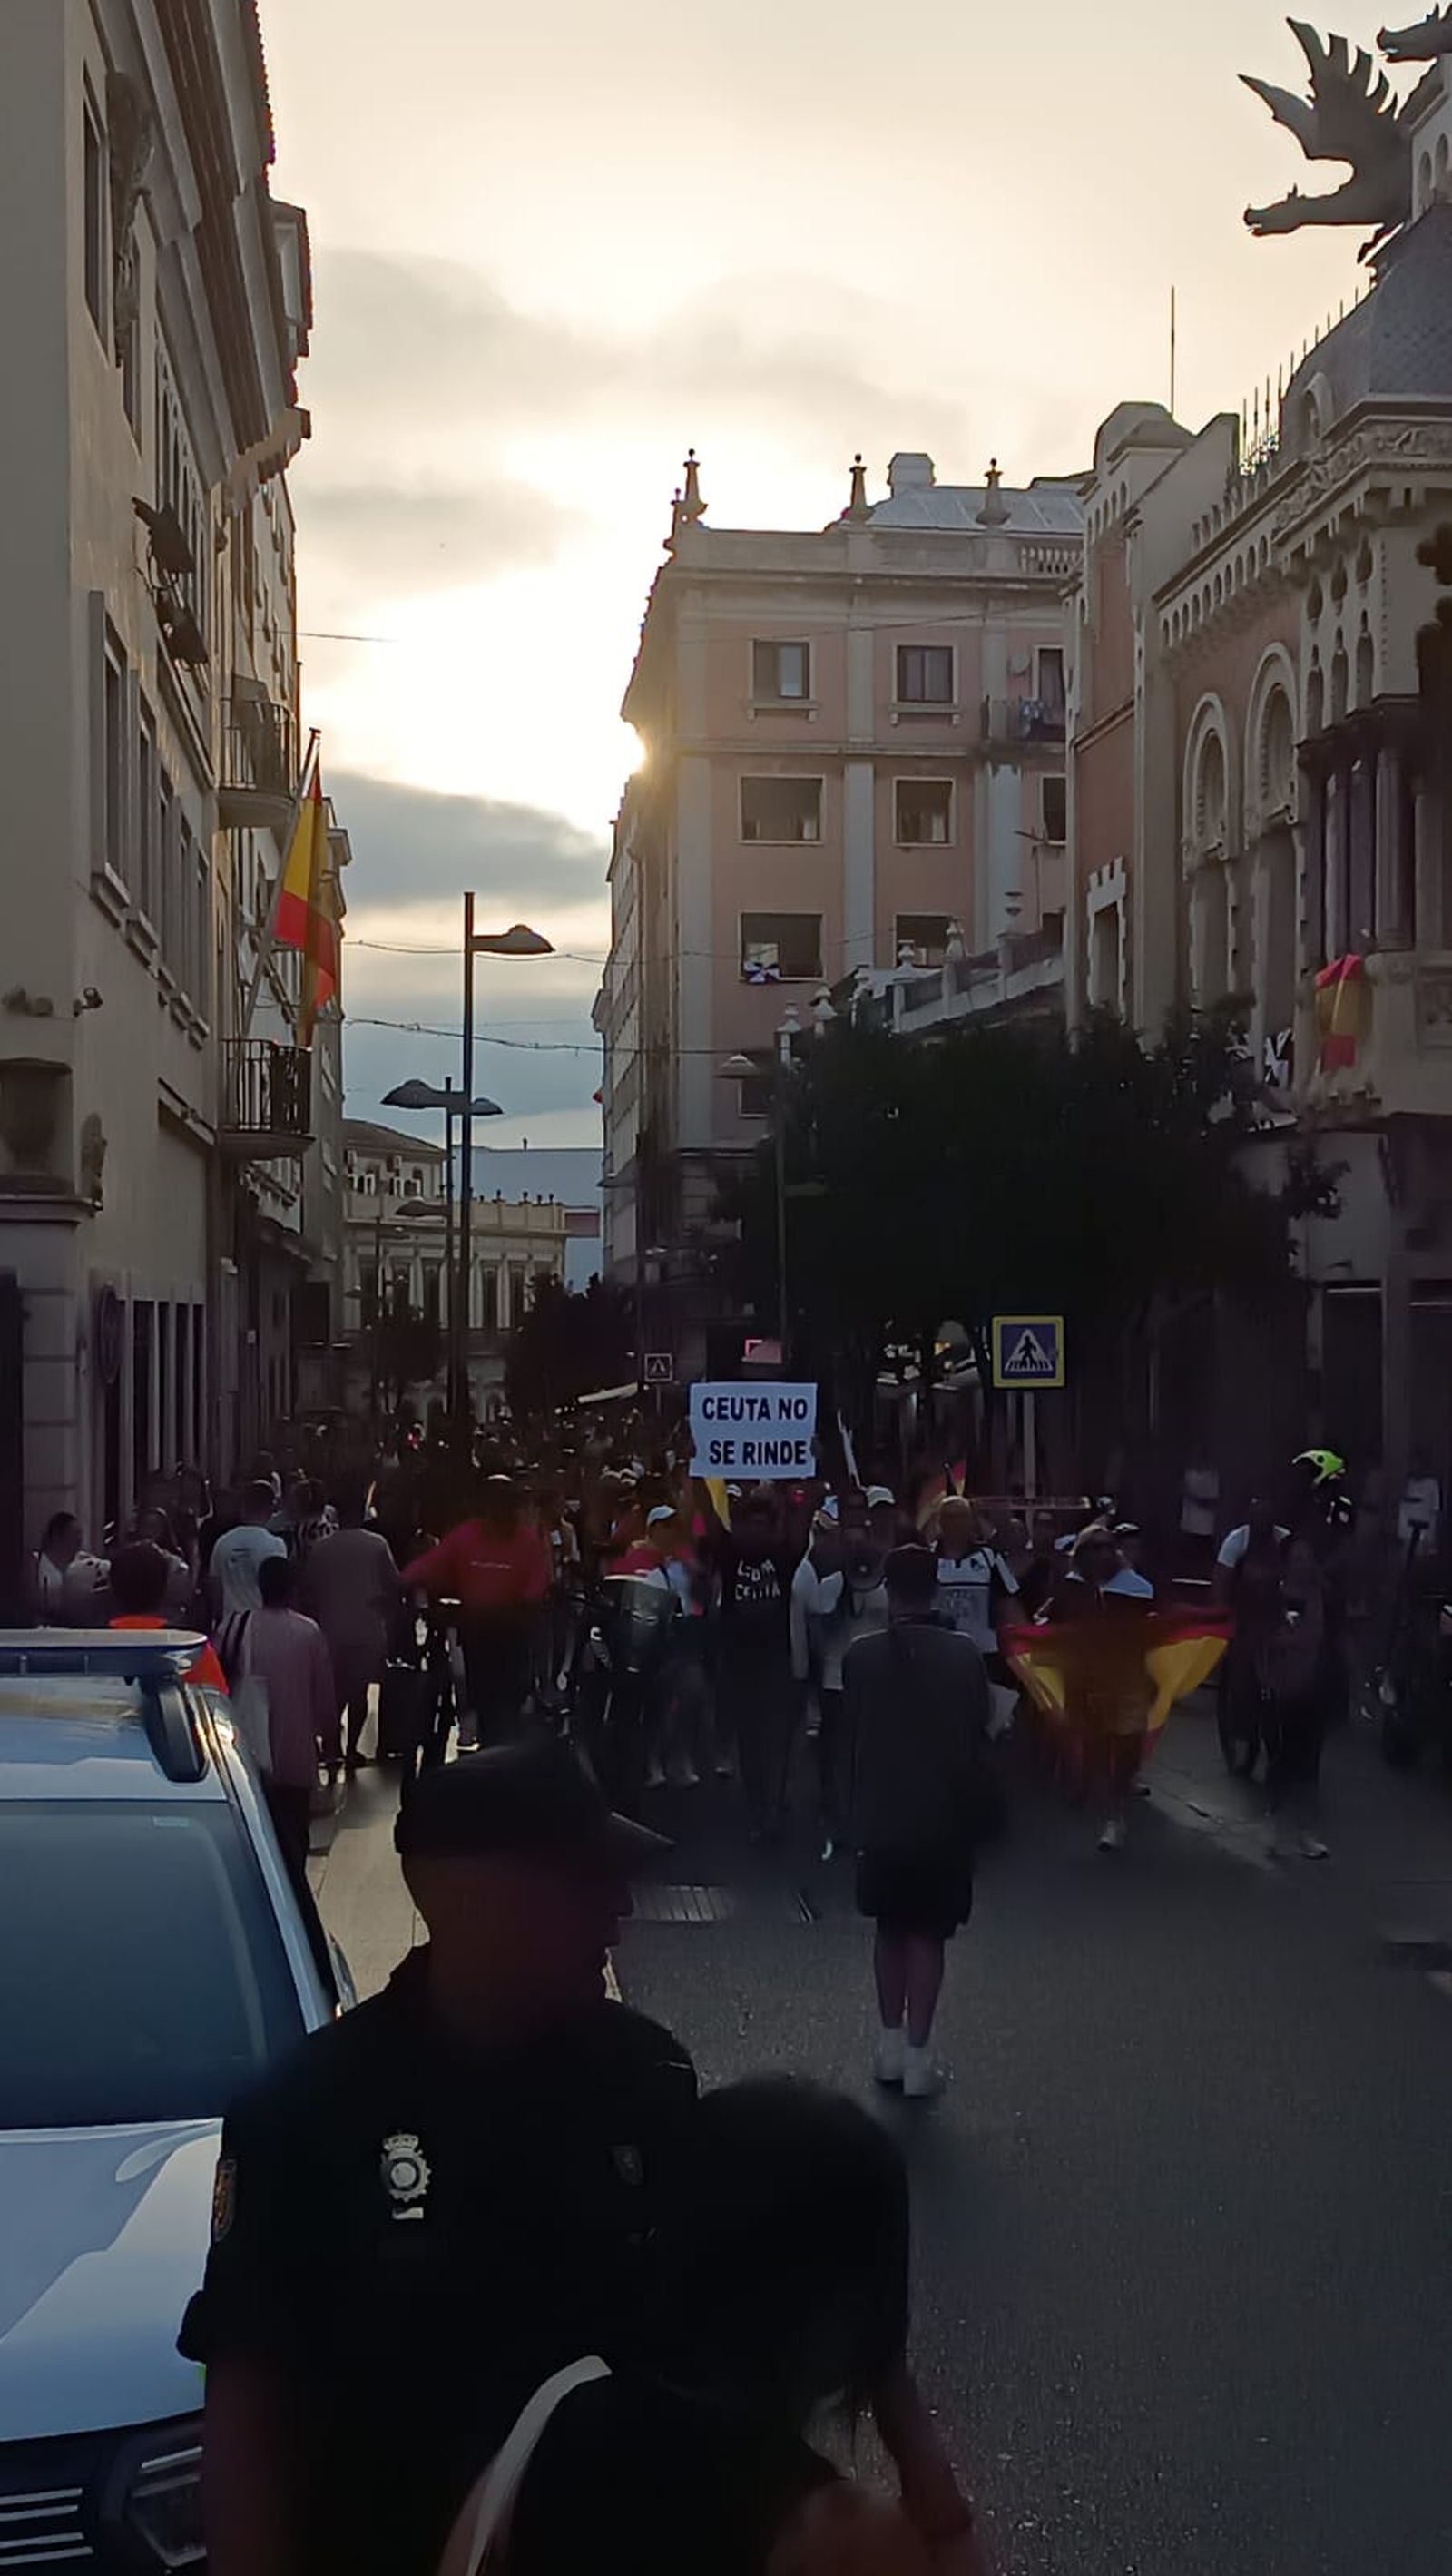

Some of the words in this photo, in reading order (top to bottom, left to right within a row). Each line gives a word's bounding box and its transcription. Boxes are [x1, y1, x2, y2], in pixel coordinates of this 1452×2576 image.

[701, 1397, 770, 1421] CEUTA
[778, 1398, 808, 1421] NO
[709, 1440, 735, 1465] SE
[742, 1440, 807, 1466] RINDE
